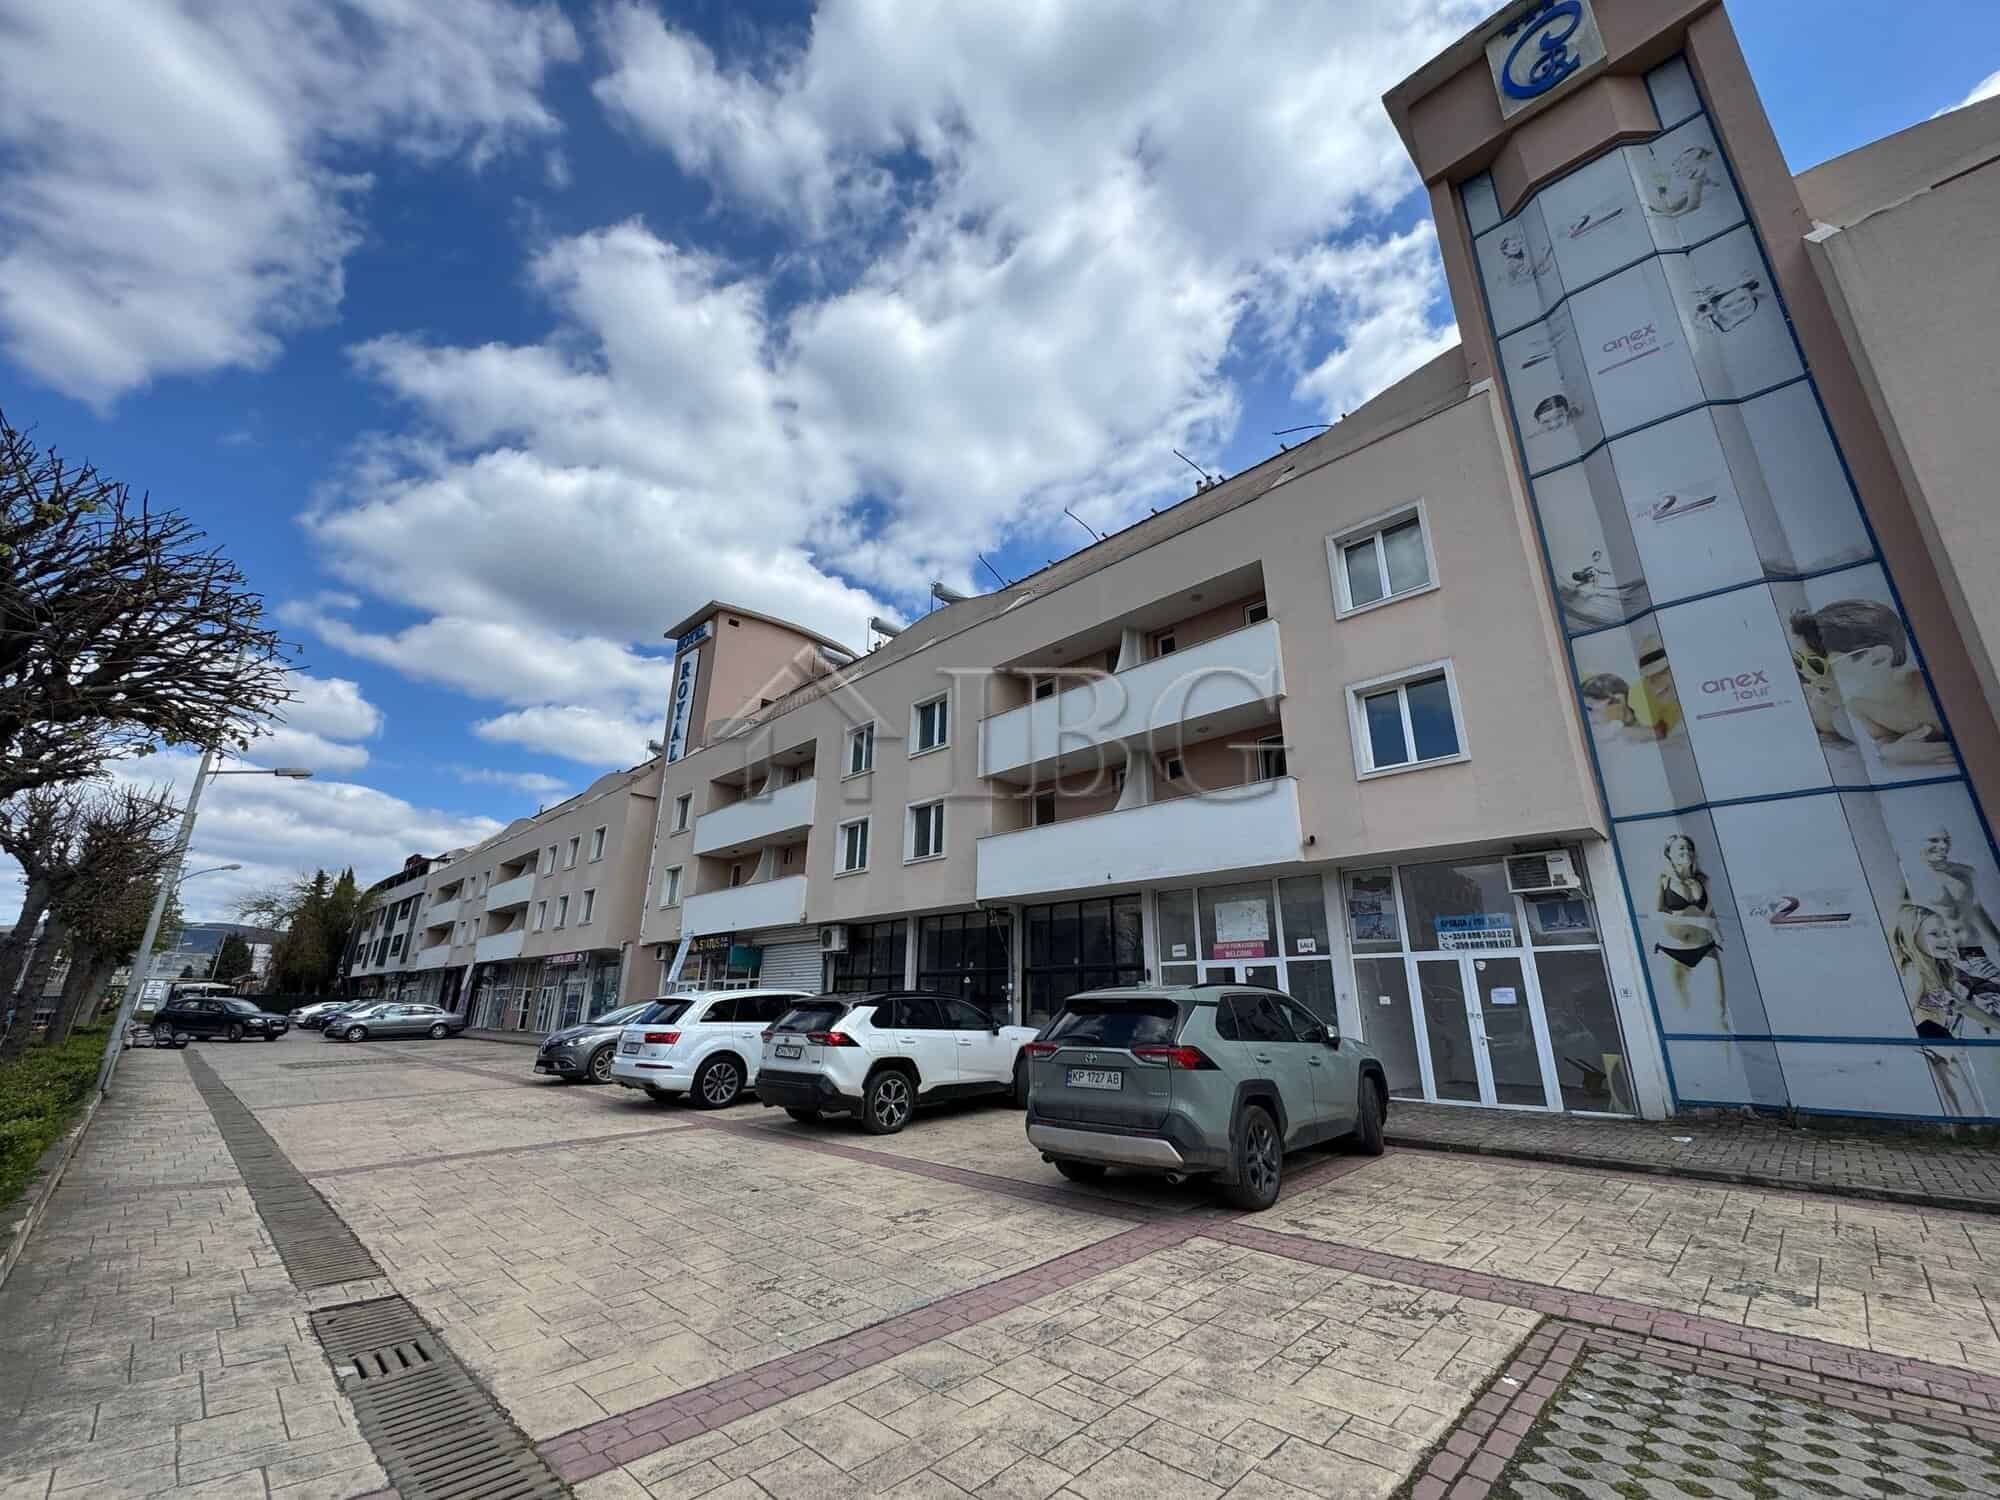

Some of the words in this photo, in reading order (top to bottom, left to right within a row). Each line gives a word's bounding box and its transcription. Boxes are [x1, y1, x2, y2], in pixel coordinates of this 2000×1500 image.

[1602, 323, 1656, 352] anex
[1701, 670, 1769, 694] anex
[1733, 687, 1769, 702] tour
[667, 661, 692, 763] ROYAL
[1072, 1071, 1085, 1081] KP
[1106, 1072, 1121, 1085] AB
